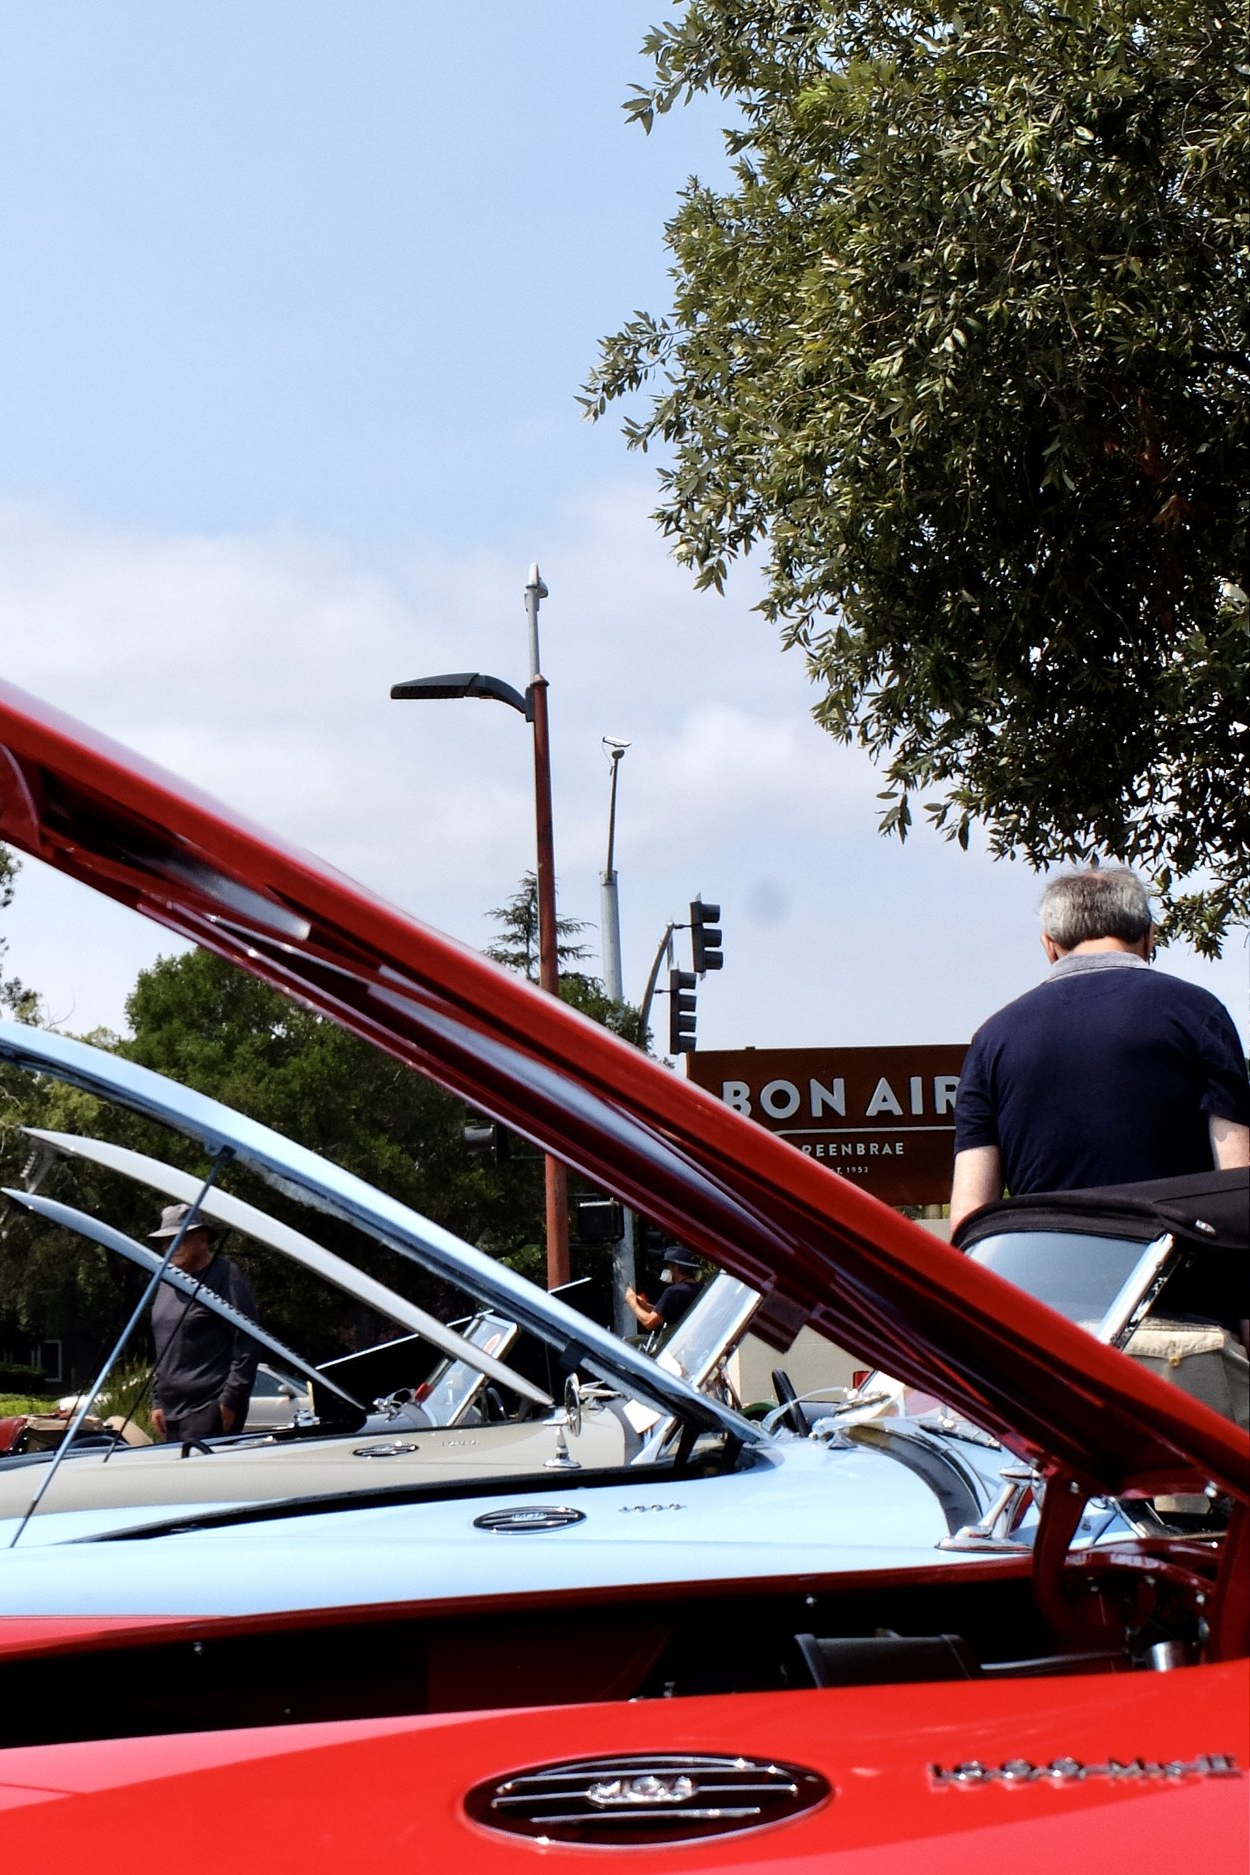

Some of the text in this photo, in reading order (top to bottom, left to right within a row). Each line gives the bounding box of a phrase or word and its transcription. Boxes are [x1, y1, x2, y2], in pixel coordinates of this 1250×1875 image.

[722, 1076, 959, 1119] BON AIR
[801, 1143, 904, 1157] REENBRAE
